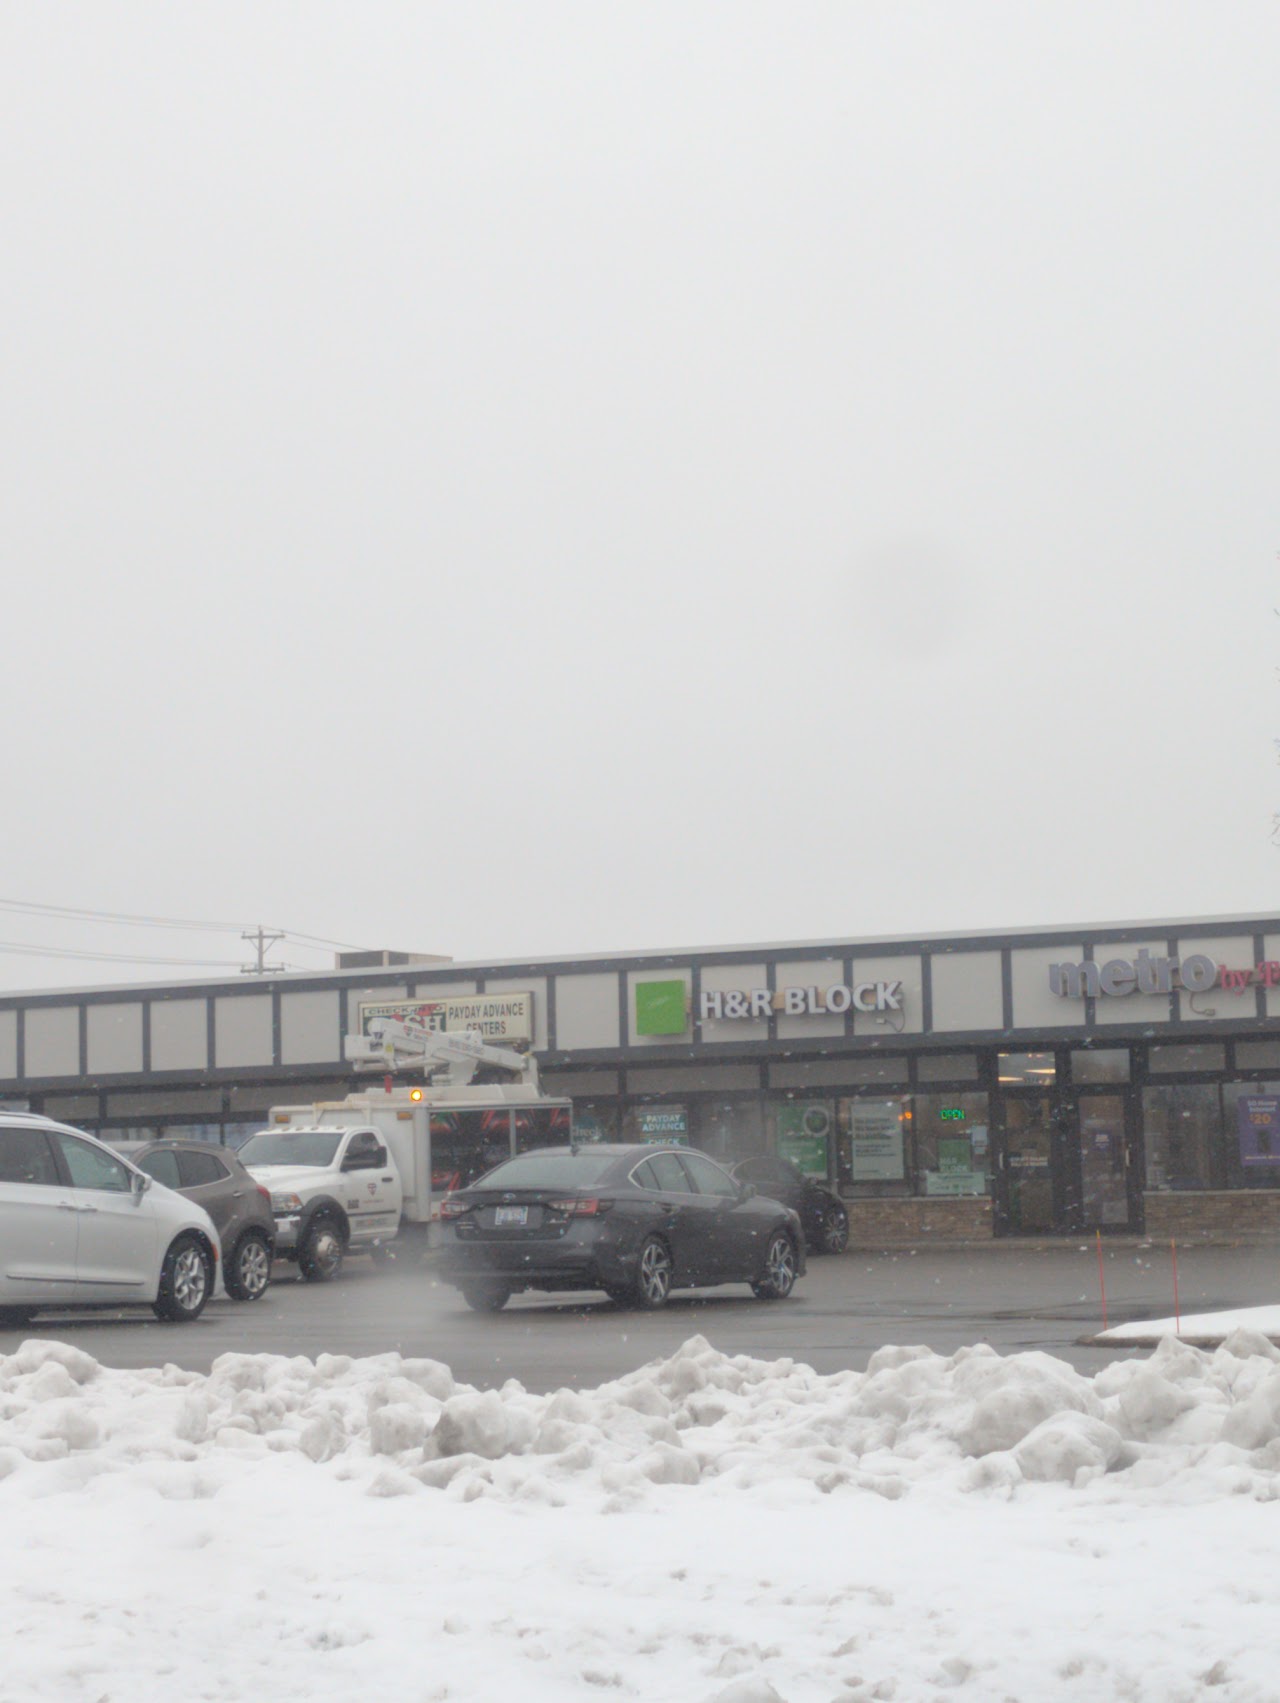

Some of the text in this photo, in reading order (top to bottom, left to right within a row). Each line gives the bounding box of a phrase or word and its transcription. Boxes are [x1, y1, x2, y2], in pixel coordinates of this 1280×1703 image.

[1049, 948, 1217, 998] metro
[1217, 963, 1250, 997] by
[700, 981, 903, 1019] H&R BLOCK
[368, 1007, 409, 1015] CHECK
[449, 1002, 524, 1020] PAYDAY ADVANCE
[646, 1114, 681, 1123] PAYDAY
[940, 1109, 965, 1120] OPEN
[642, 1122, 686, 1132] ADVANCE
